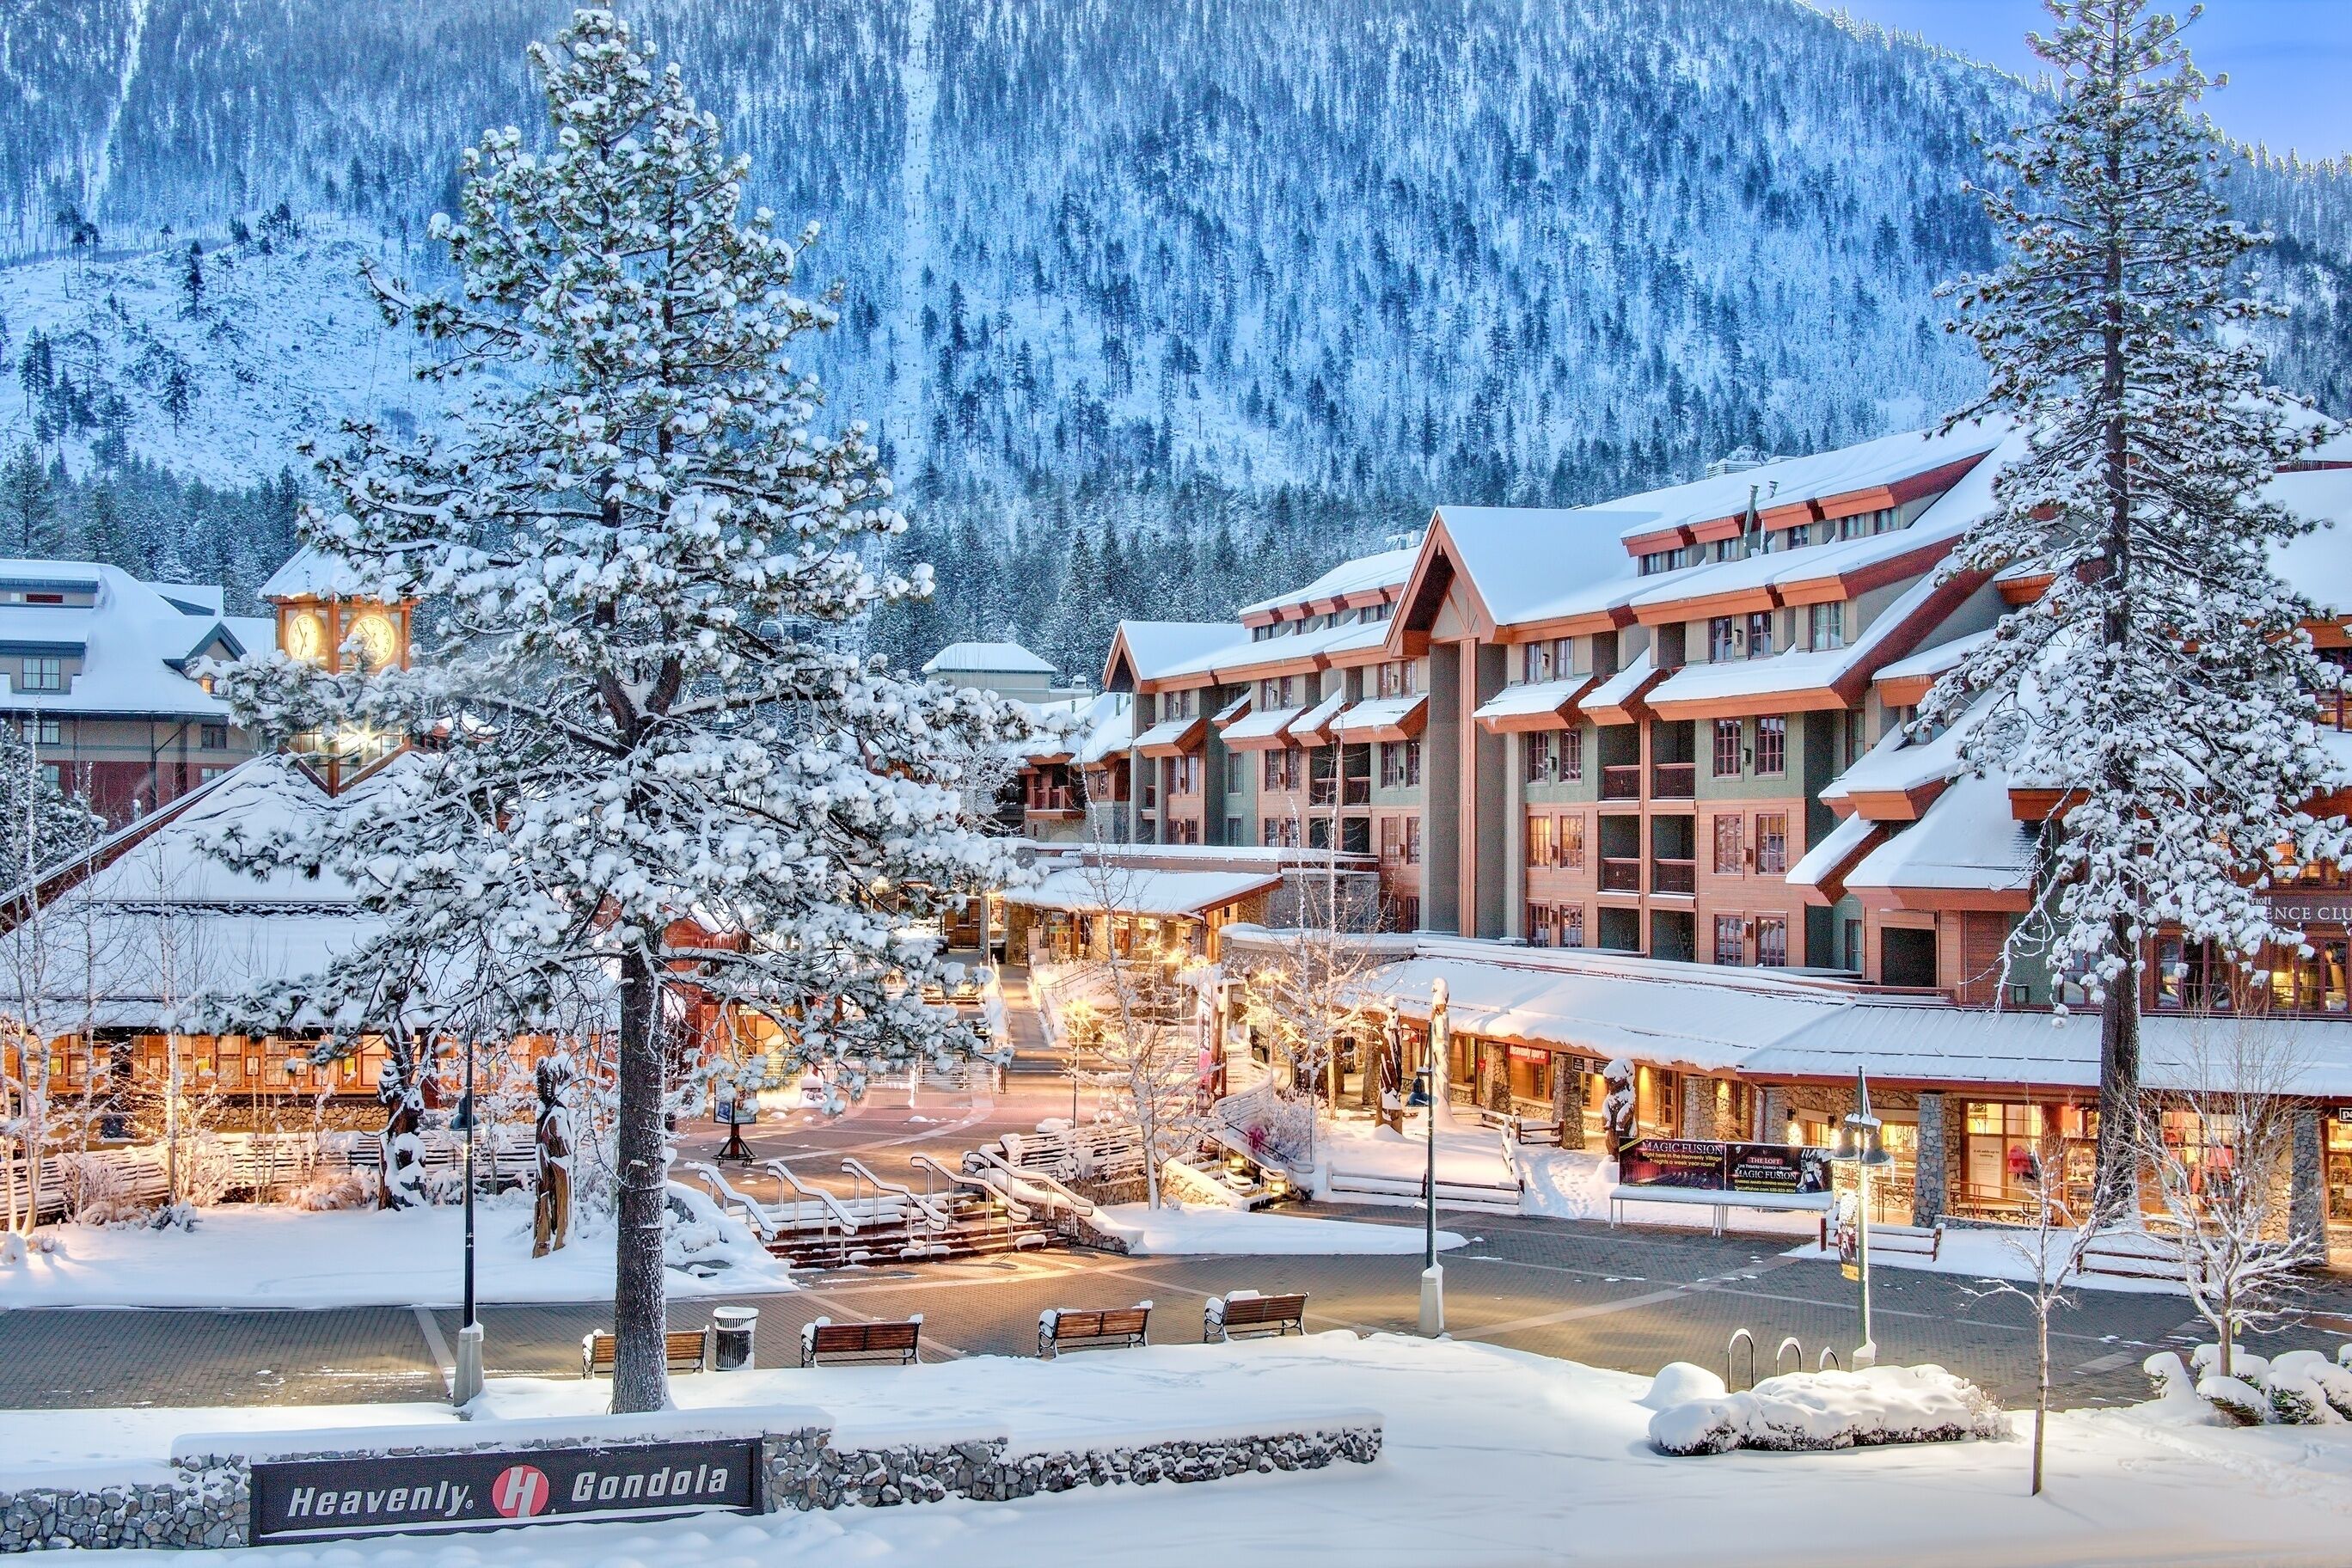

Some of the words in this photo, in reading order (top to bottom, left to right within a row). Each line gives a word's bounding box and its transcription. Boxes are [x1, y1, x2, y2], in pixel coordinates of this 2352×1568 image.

[2318, 907, 2352, 920] CLU
[1642, 1141, 1680, 1153] MAGIC
[1682, 1143, 1723, 1155] FUSION
[1735, 1168, 1764, 1179] MAGIC
[1765, 1170, 1797, 1179] FUSION
[502, 1467, 539, 1517] H
[572, 1464, 728, 1502] Gondola
